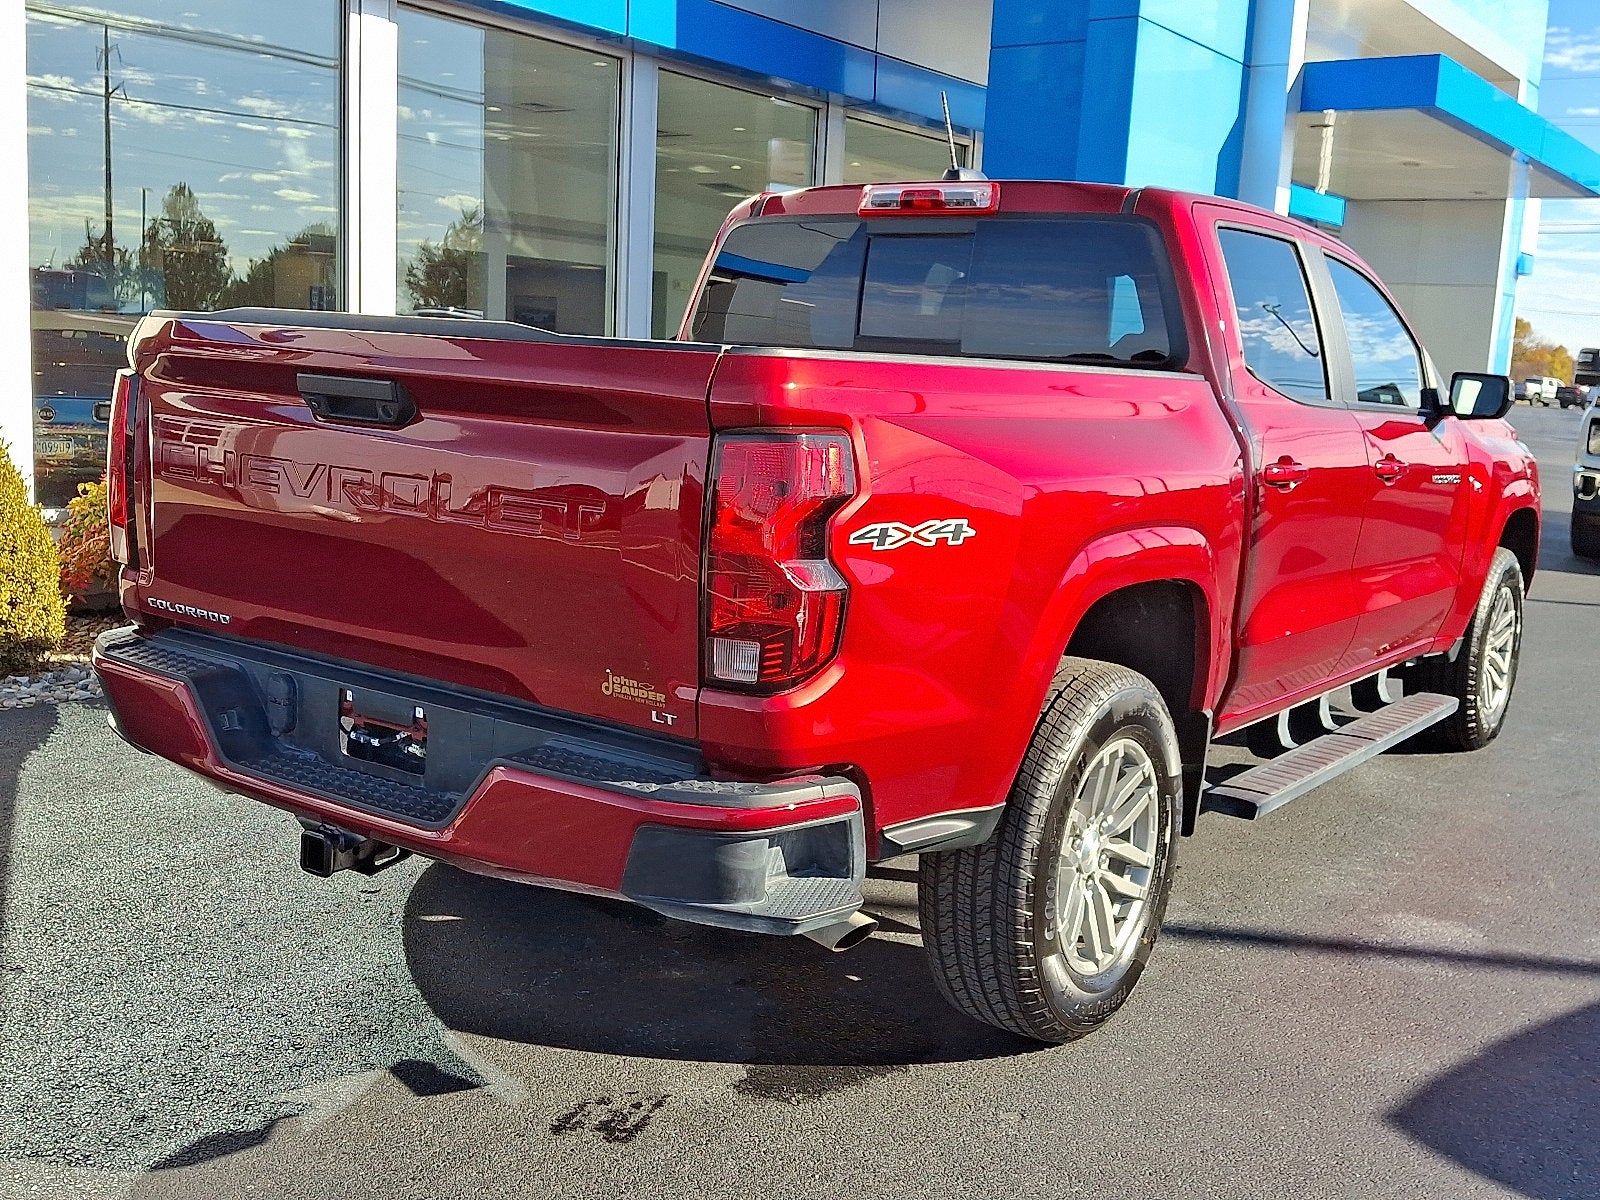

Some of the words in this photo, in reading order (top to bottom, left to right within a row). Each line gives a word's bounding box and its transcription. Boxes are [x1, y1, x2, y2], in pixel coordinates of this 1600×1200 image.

[159, 440, 607, 540] CHEVROLET
[147, 597, 231, 624] COLORADO
[613, 683, 666, 703] SAUDER
[651, 710, 678, 726] LT
